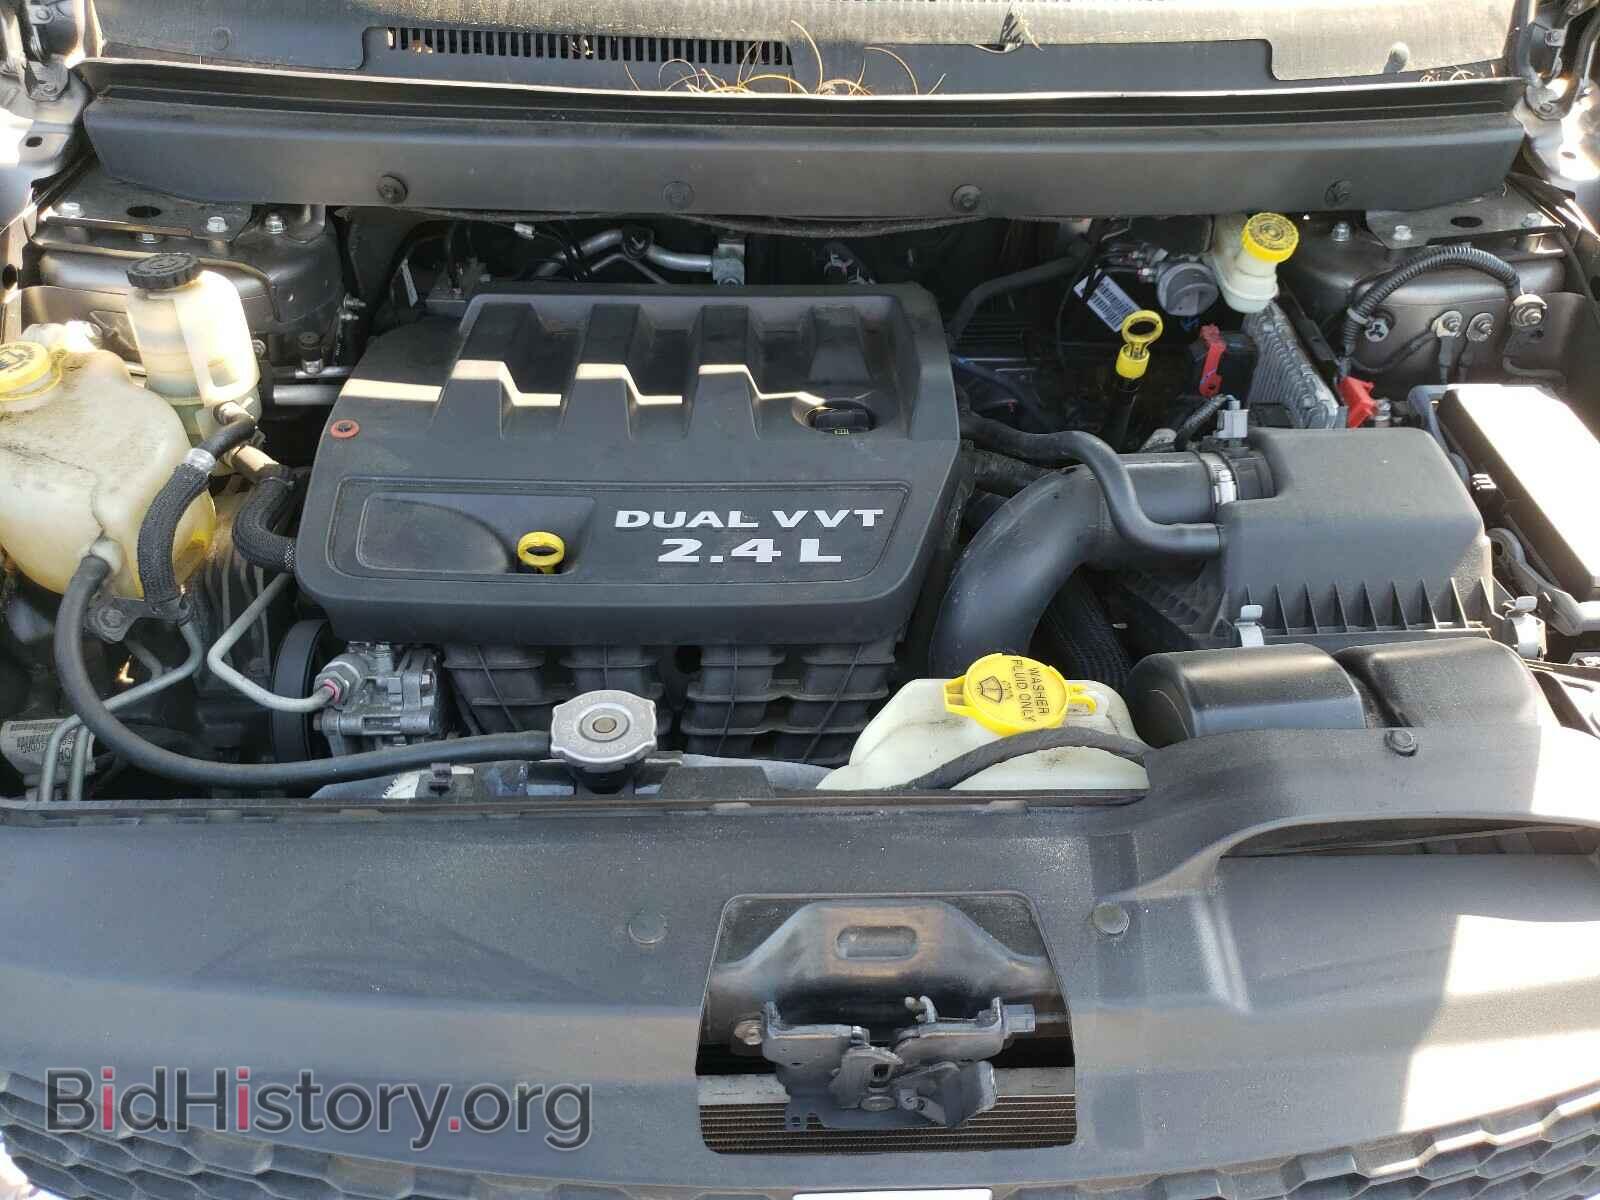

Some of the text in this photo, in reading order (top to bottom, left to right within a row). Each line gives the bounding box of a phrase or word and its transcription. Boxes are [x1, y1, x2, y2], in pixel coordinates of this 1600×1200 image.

[614, 508, 884, 529] DUAL VVT
[657, 538, 782, 563] 2.4
[1012, 660, 1036, 722] FLUID ONLY
[1030, 667, 1049, 714] WASHER
